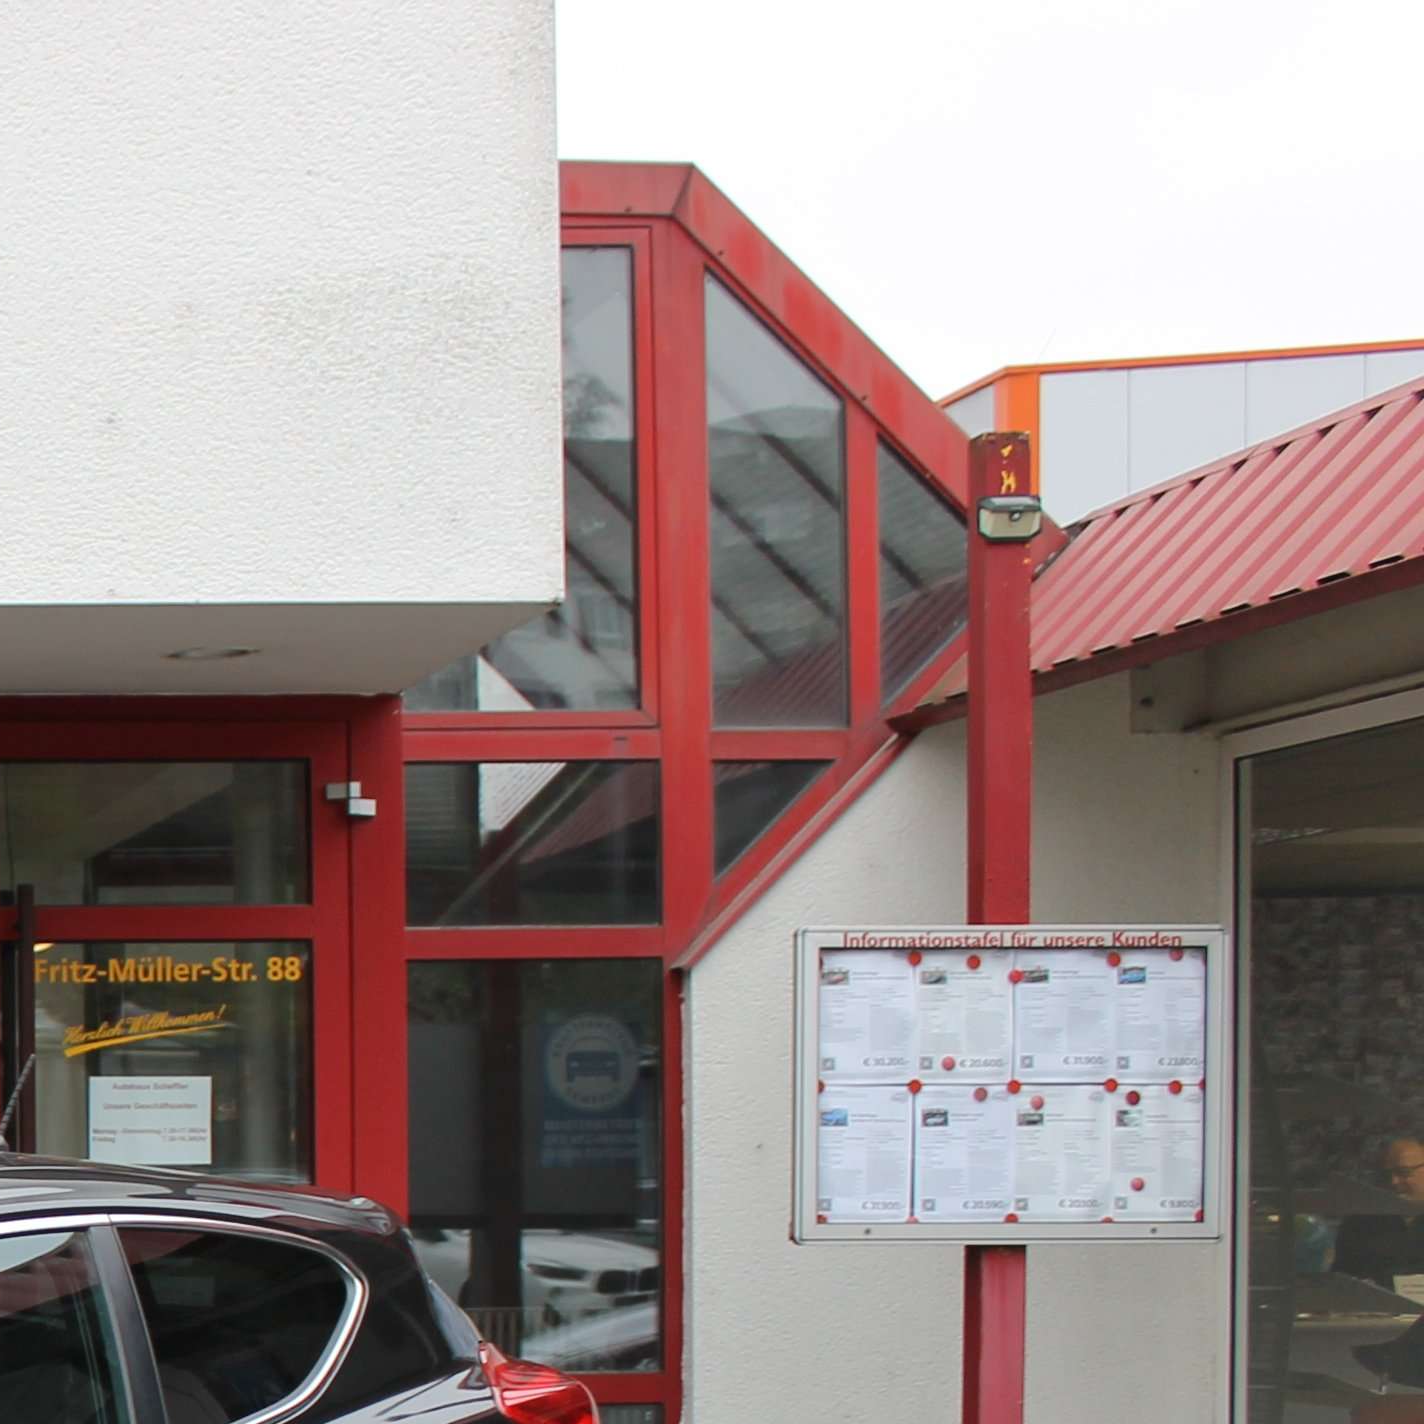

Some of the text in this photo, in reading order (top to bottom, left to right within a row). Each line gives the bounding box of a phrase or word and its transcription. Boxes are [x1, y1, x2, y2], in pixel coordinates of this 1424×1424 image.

[843, 930, 1183, 947] Informationstafel für unsere Kunden
[33, 955, 301, 983] Fritz-Müller-Str. 88
